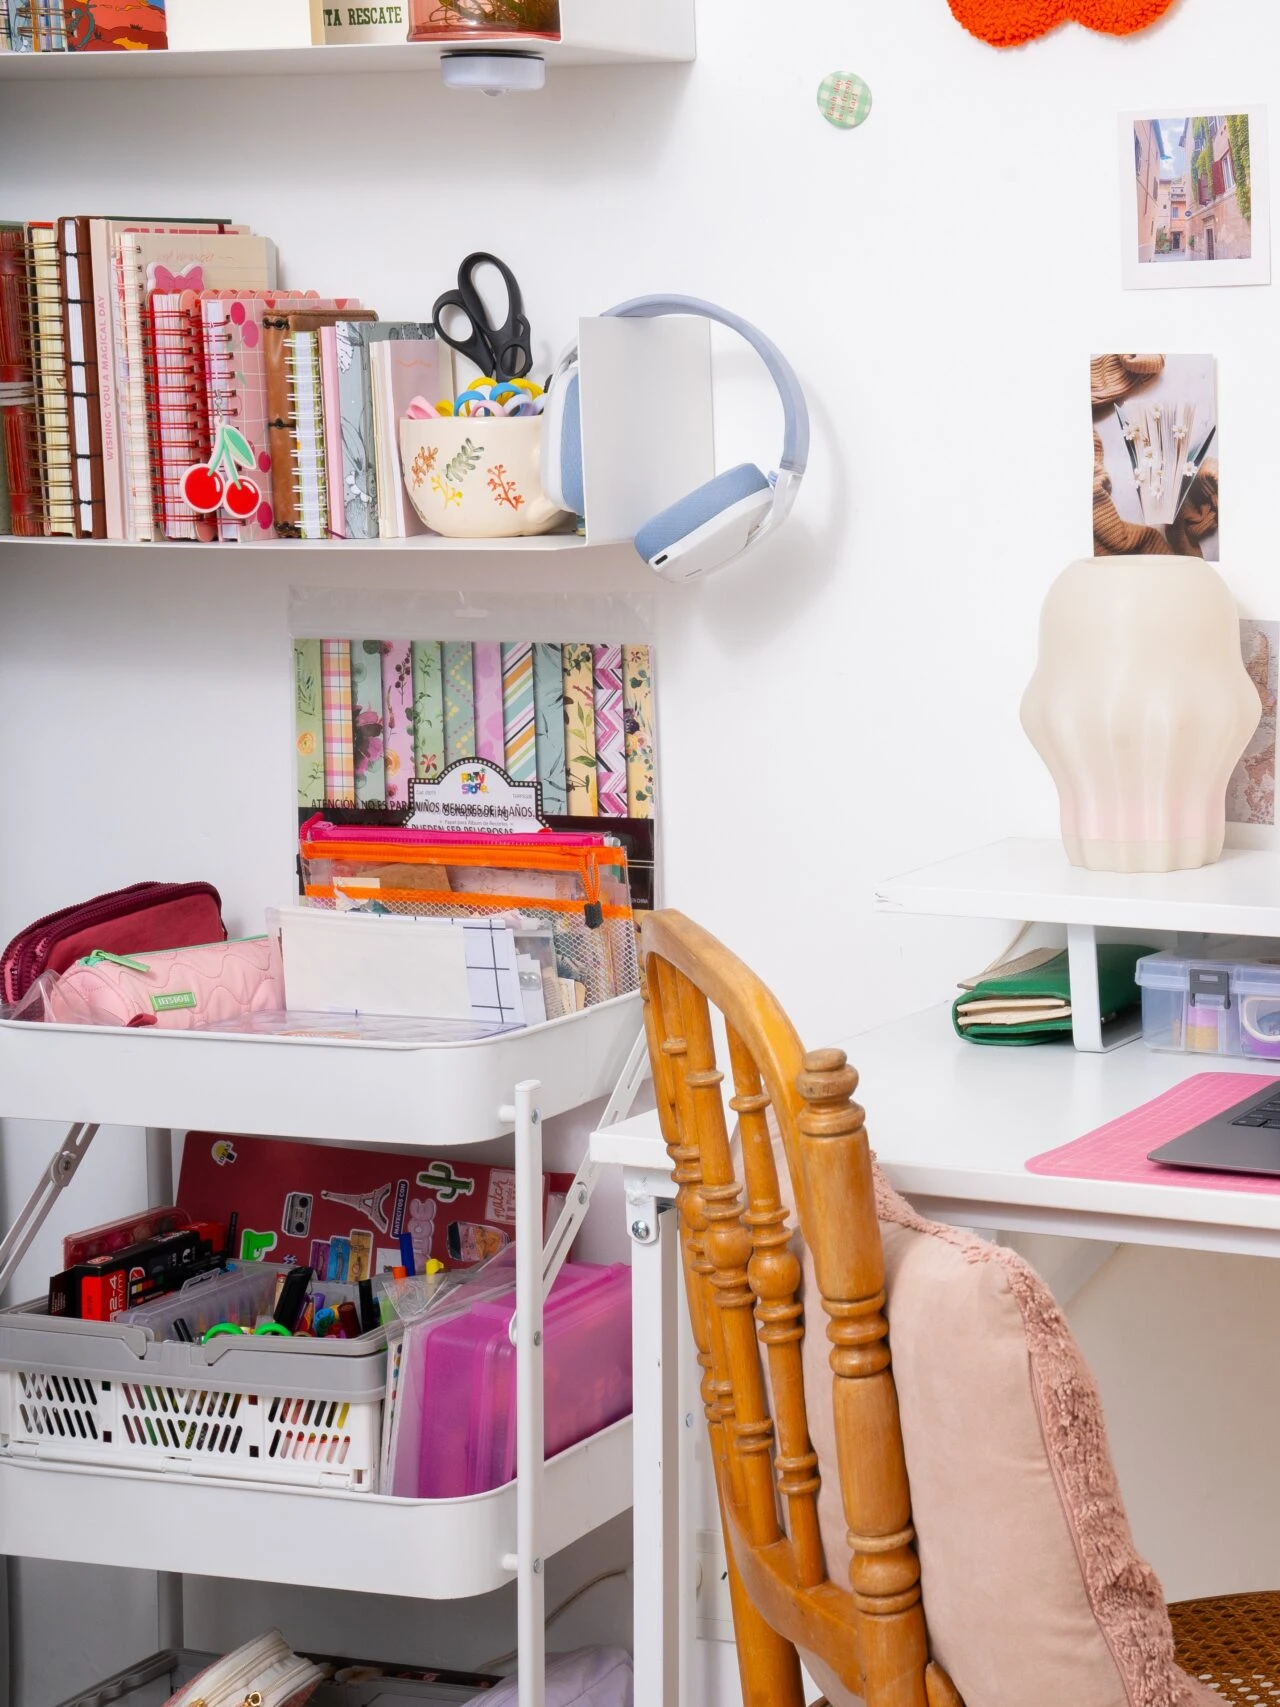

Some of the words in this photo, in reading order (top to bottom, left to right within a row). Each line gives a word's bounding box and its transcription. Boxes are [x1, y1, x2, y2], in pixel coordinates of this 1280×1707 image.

[323, 9, 342, 26] TA
[347, 6, 402, 26] RESCATE
[98, 296, 106, 317] DAY
[101, 320, 109, 371] MAGICAL
[103, 373, 110, 381] A
[103, 384, 111, 409] YOU
[105, 411, 114, 461] WISHING
[415, 799, 440, 813] NIÑOS
[393, 1198, 404, 1235] MATECITOS
[399, 1183, 407, 1198] CON
